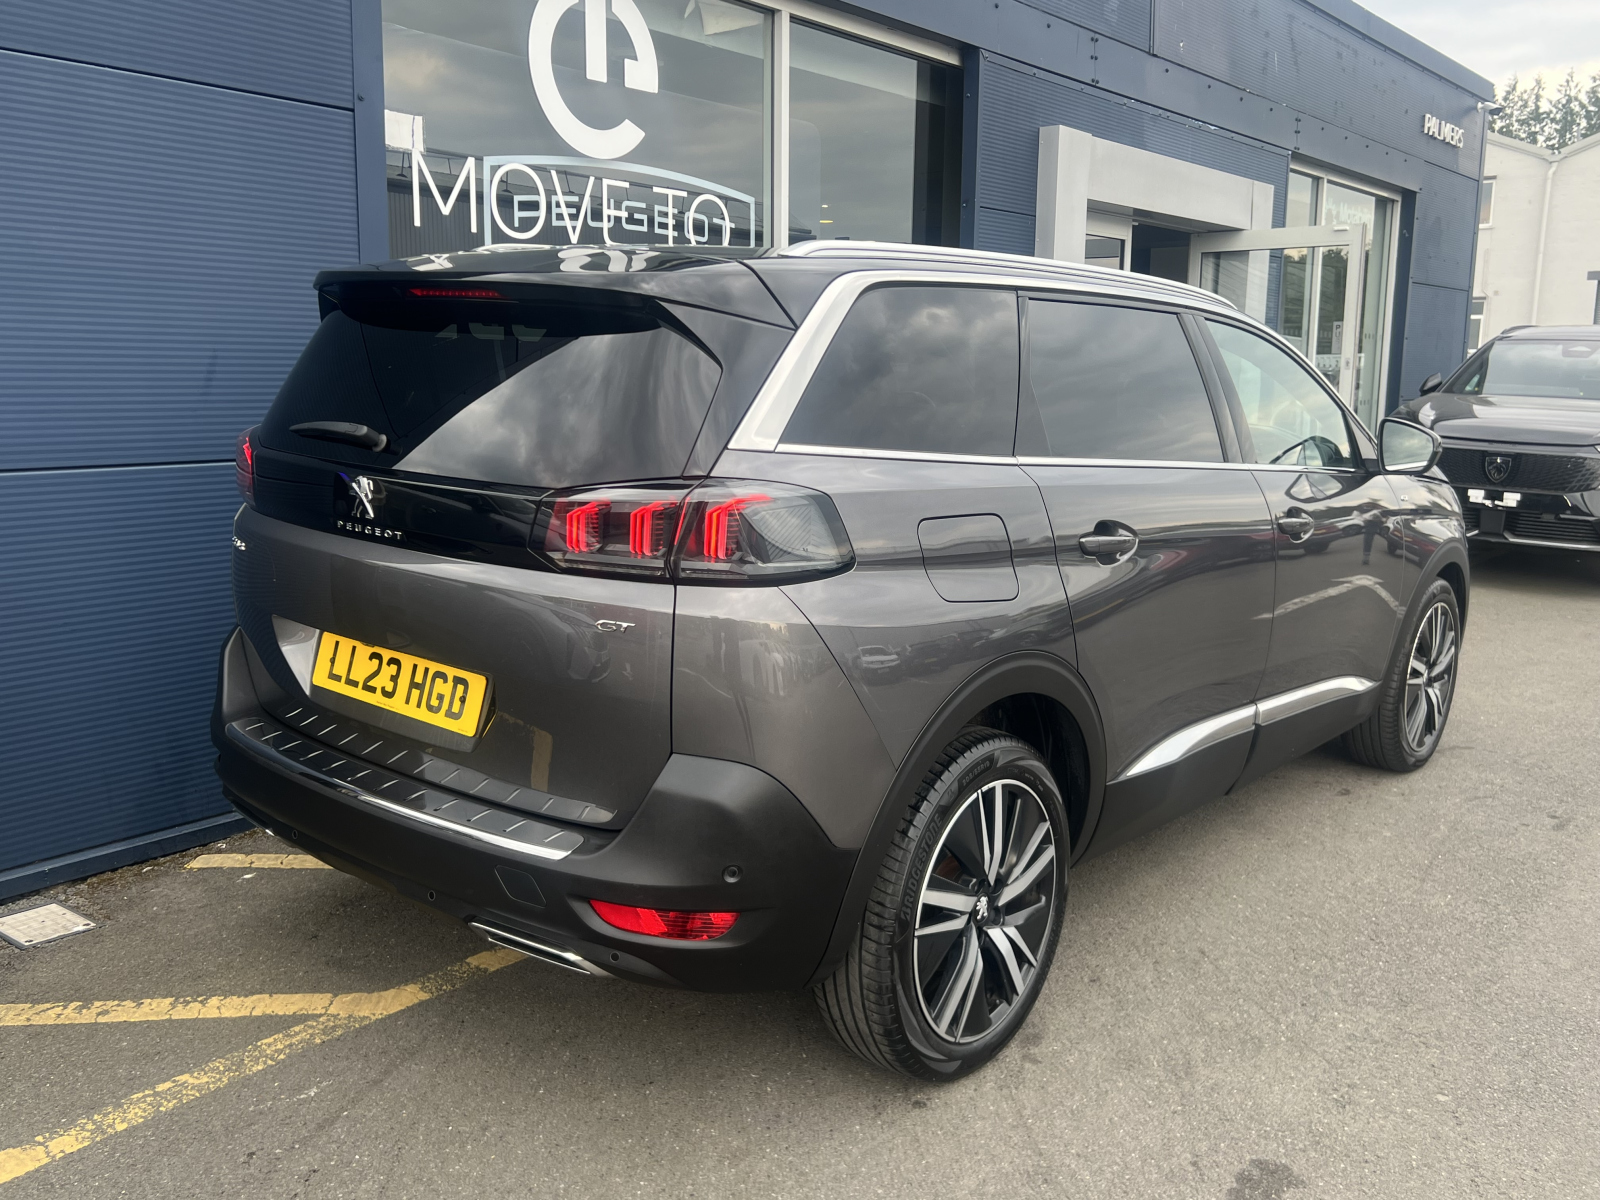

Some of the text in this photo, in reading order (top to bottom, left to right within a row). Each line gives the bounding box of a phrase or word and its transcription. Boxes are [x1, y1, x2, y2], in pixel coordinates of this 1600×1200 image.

[1423, 113, 1465, 149] PALMERS
[512, 194, 736, 247] PEUGEOT
[337, 520, 402, 540] PEUGEOT
[595, 619, 636, 633] GT
[327, 640, 470, 721] LL23 HGD
[901, 812, 943, 921] BRIDGESTONE
